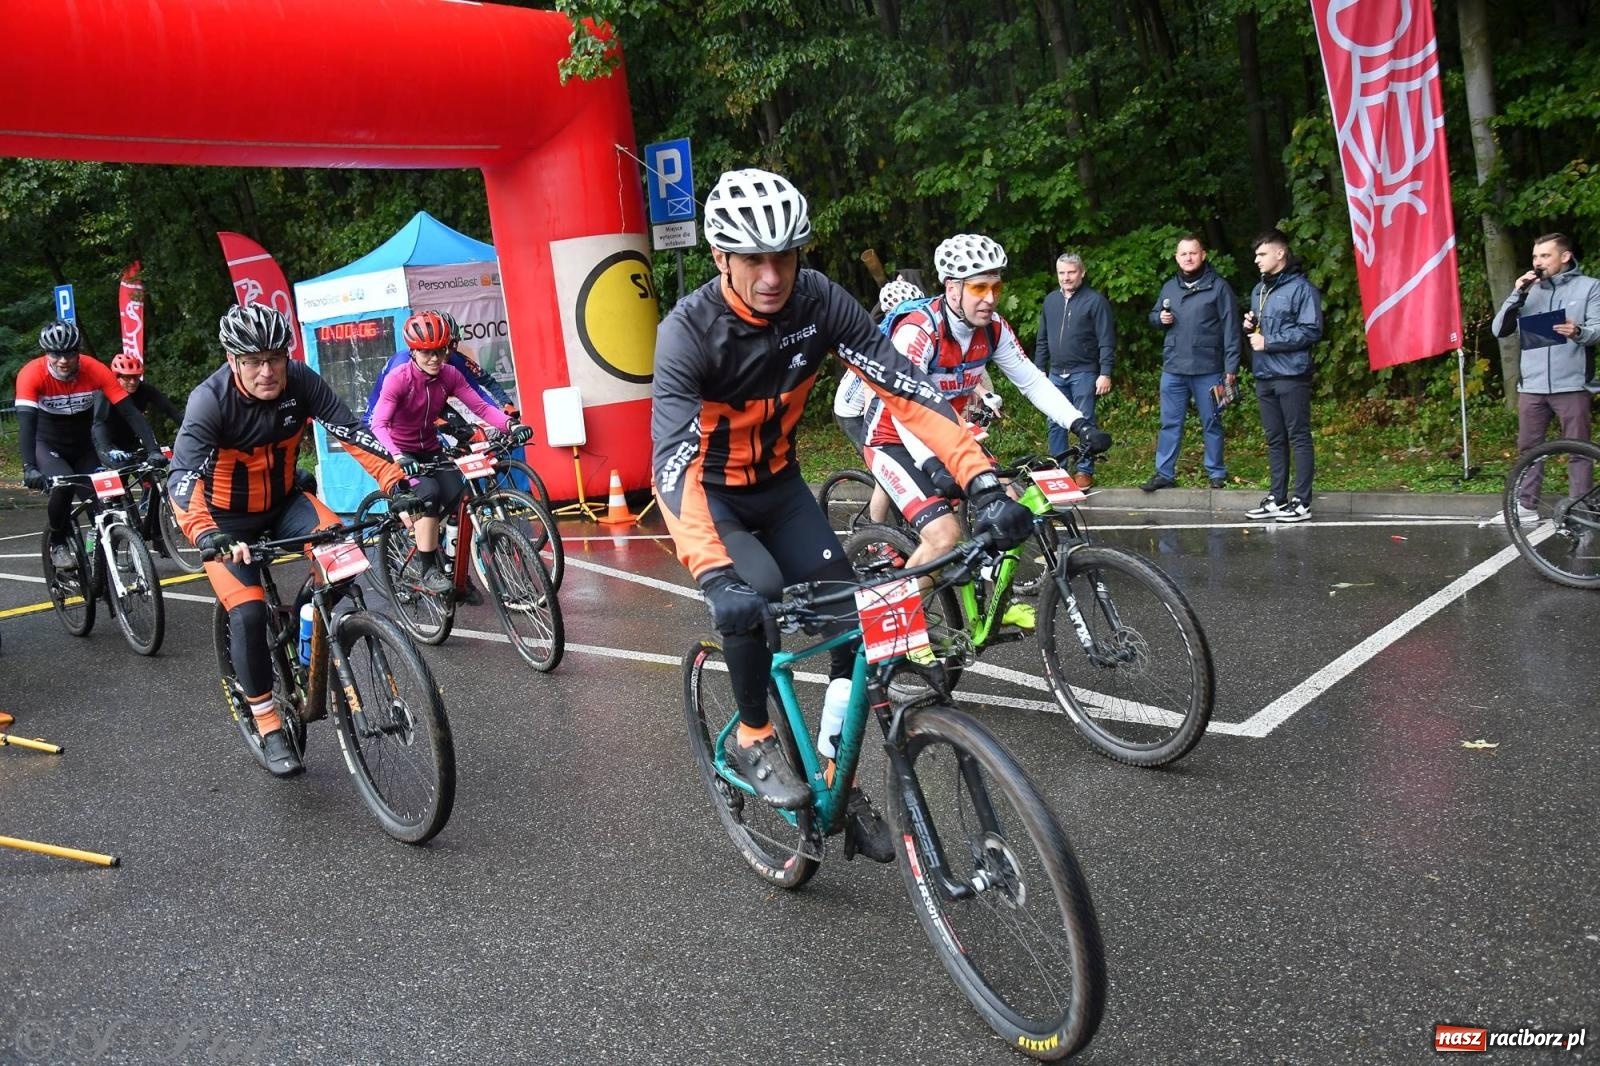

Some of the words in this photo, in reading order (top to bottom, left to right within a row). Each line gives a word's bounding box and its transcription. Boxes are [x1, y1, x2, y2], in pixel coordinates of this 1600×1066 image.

[656, 149, 682, 199] P
[418, 276, 478, 291] PersonalBest
[59, 289, 70, 318] P
[893, 370, 944, 404] TEAM
[1046, 480, 1070, 490] 26
[881, 606, 908, 633] 21
[909, 806, 940, 868] REBA
[1018, 1033, 1058, 1052] MAXXIS
